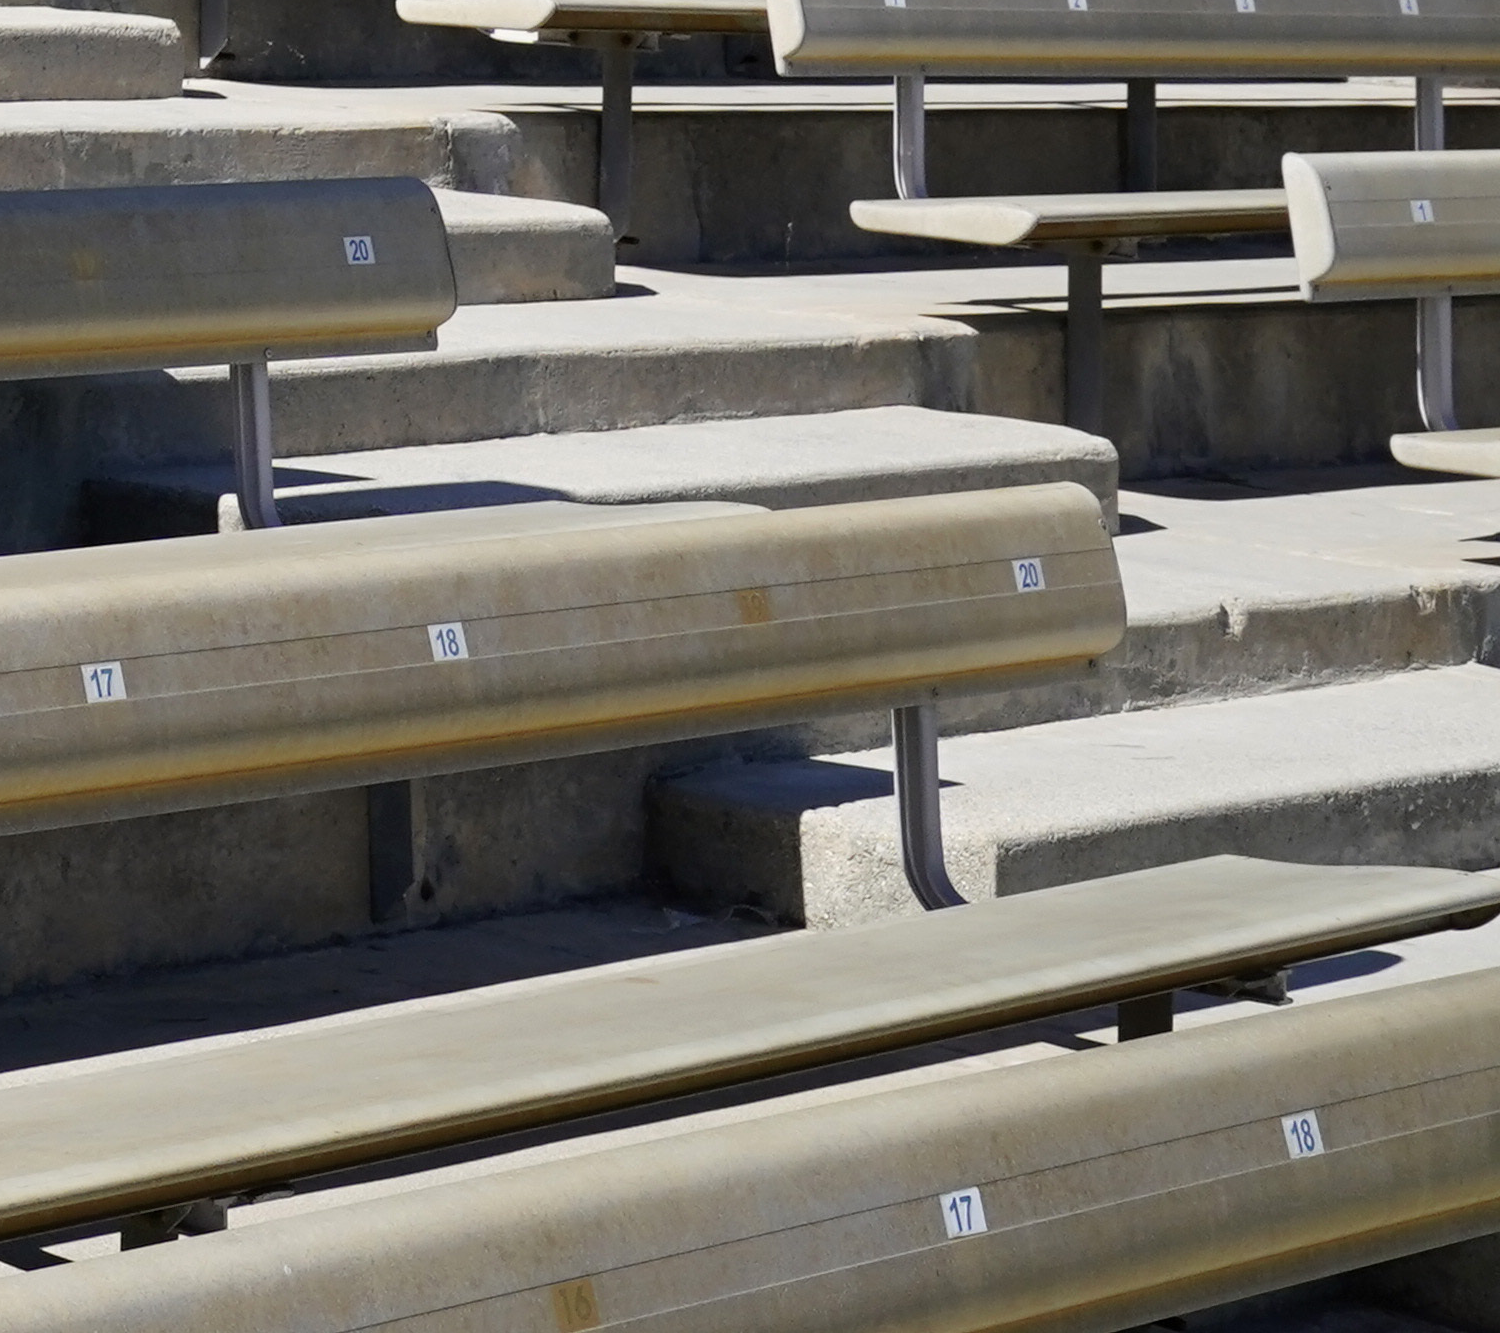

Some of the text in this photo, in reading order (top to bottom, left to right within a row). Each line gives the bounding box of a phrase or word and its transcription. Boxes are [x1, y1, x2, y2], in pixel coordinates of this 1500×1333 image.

[350, 240, 368, 261] 20
[1019, 563, 1038, 588] 20
[436, 629, 459, 657] 18
[91, 669, 112, 698] 17
[1291, 1119, 1315, 1153] 18
[950, 1196, 971, 1232] 17
